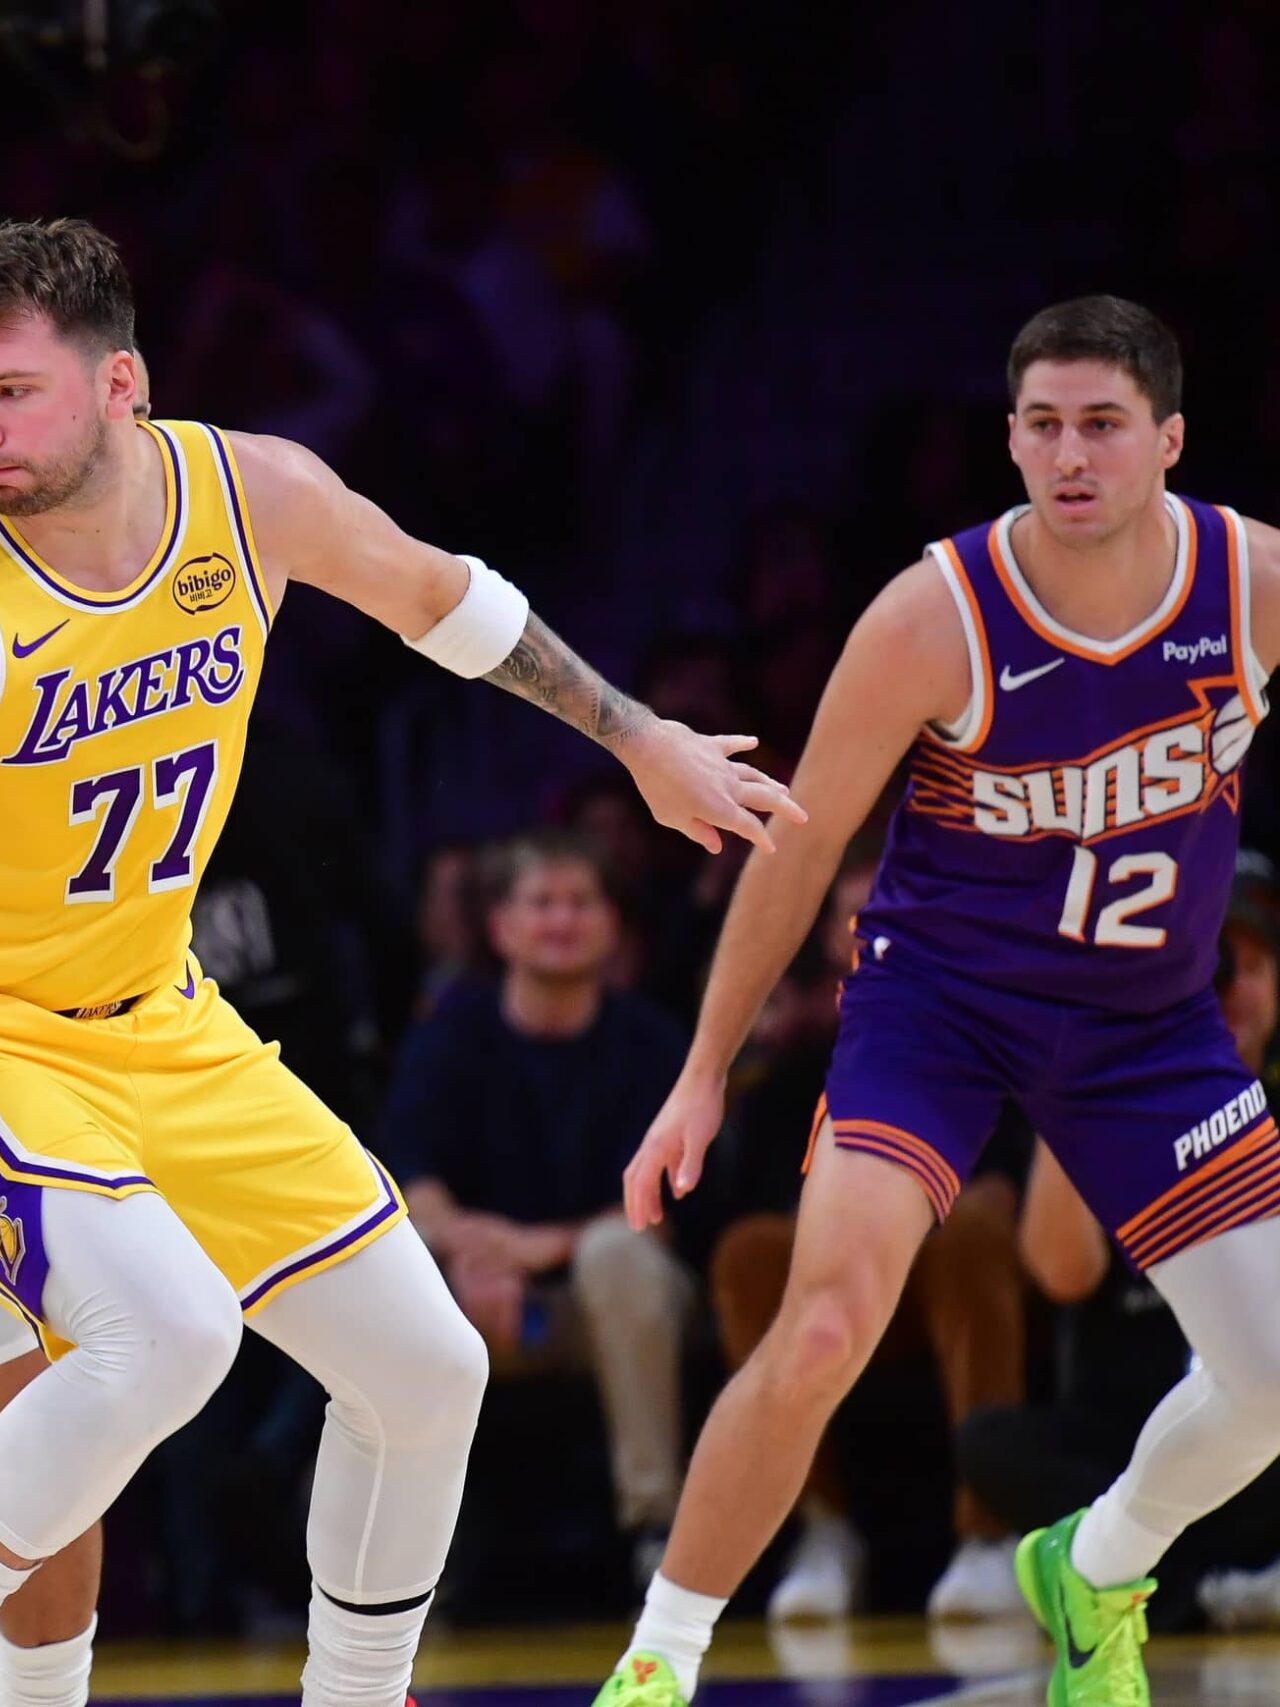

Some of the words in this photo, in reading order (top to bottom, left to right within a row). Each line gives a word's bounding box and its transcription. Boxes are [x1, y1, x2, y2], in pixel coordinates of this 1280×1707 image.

[177, 568, 232, 596] bibigo
[1162, 633, 1228, 666] PayPal
[63, 739, 220, 907] 77
[972, 724, 1205, 841] SUNS
[1057, 845, 1179, 947] 12
